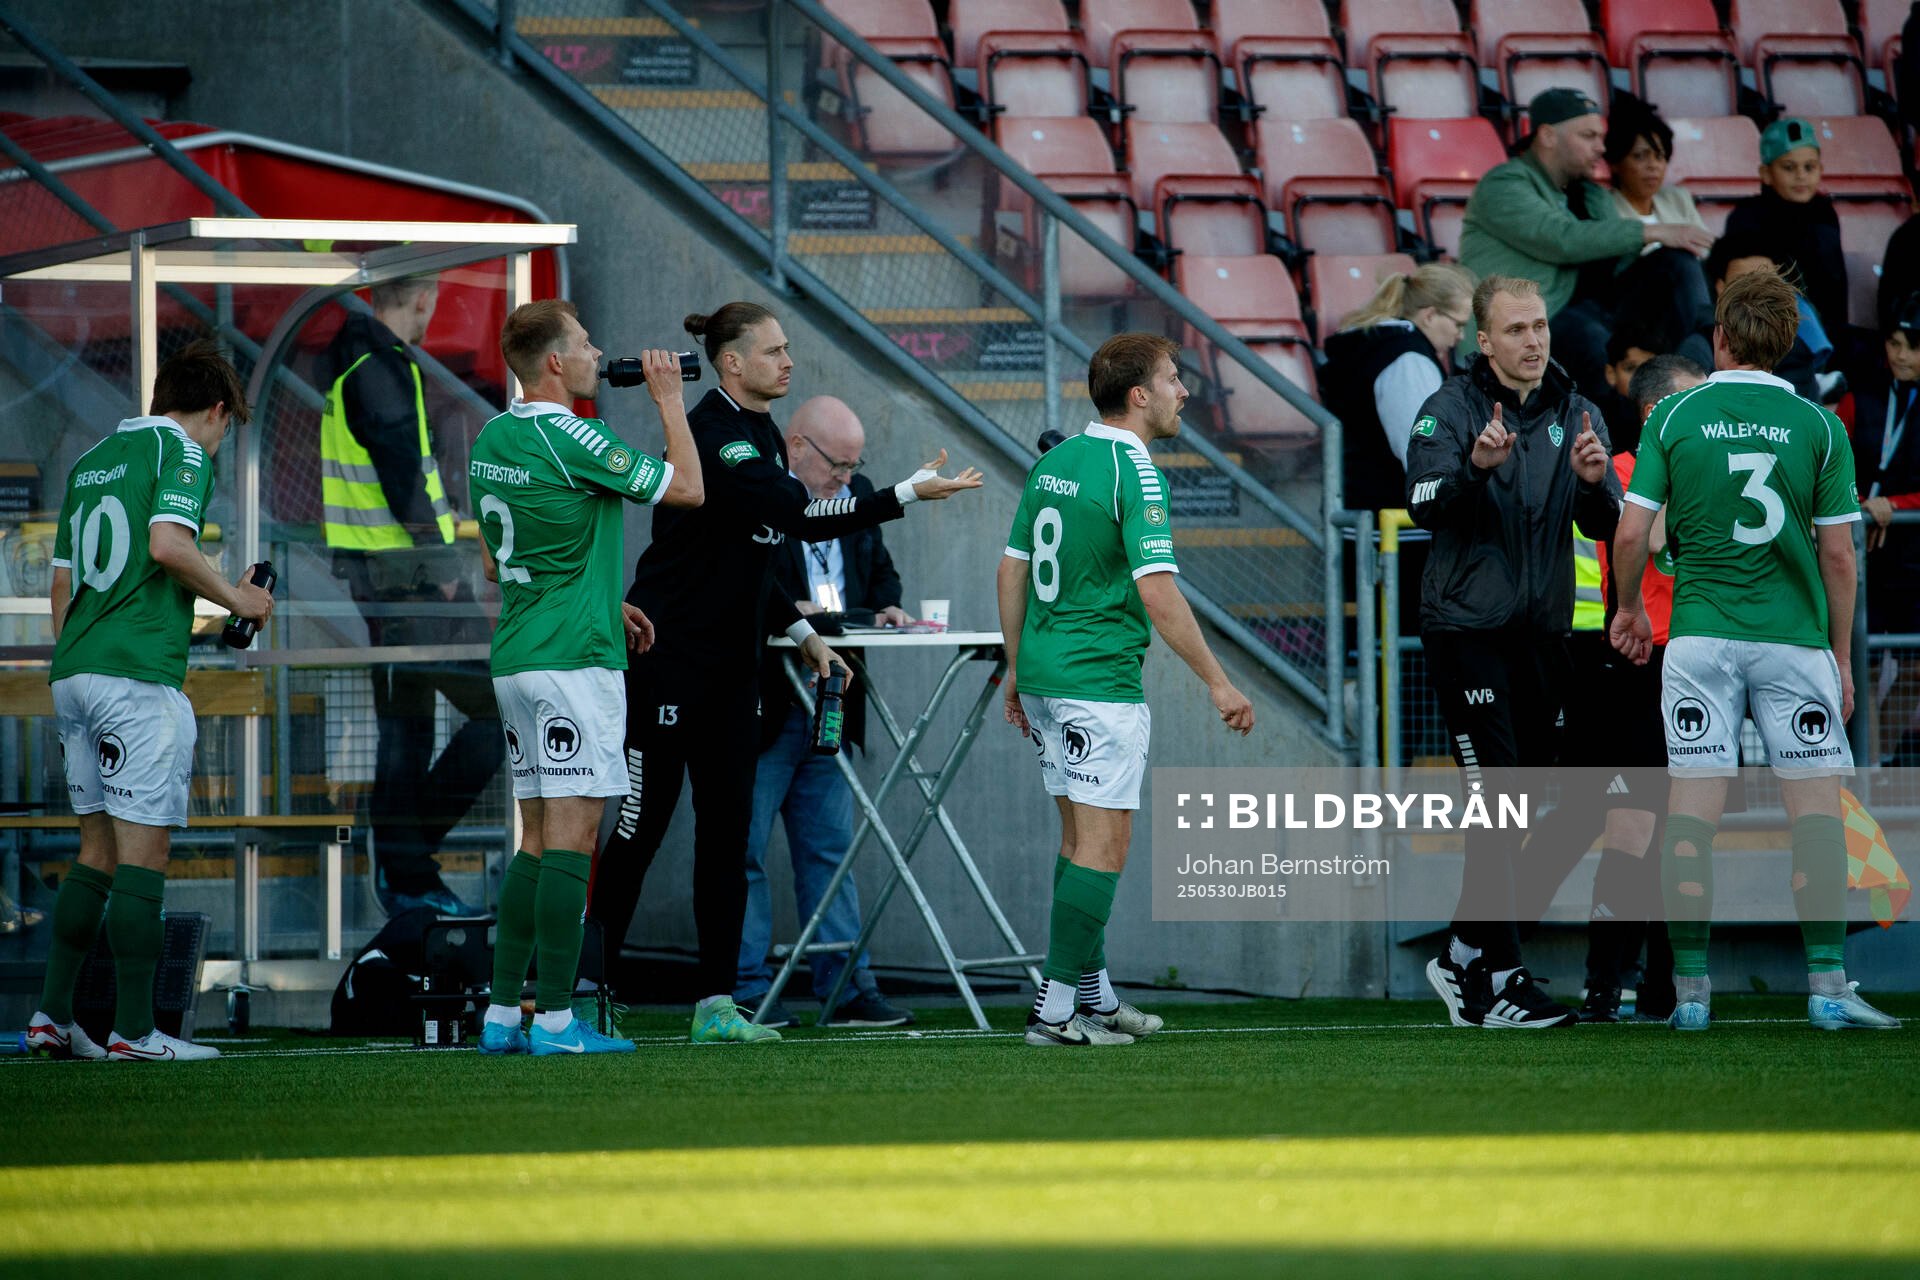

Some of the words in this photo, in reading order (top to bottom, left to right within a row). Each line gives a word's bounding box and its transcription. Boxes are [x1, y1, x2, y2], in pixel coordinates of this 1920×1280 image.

[723, 444, 753, 459] UNIBET
[470, 460, 530, 485] ETTERSTRÖM
[630, 457, 653, 492] UNIBET
[162, 493, 199, 510] UNIBET
[1727, 452, 1785, 544] 3
[69, 495, 130, 600] 10
[480, 494, 531, 584] 2
[1032, 506, 1063, 602] 8
[1464, 688, 1495, 705] WB
[658, 704, 679, 726] 13
[1669, 744, 1726, 756] OXODONTA
[1779, 746, 1842, 759] LOXODONTA
[423, 976, 430, 991] 6
